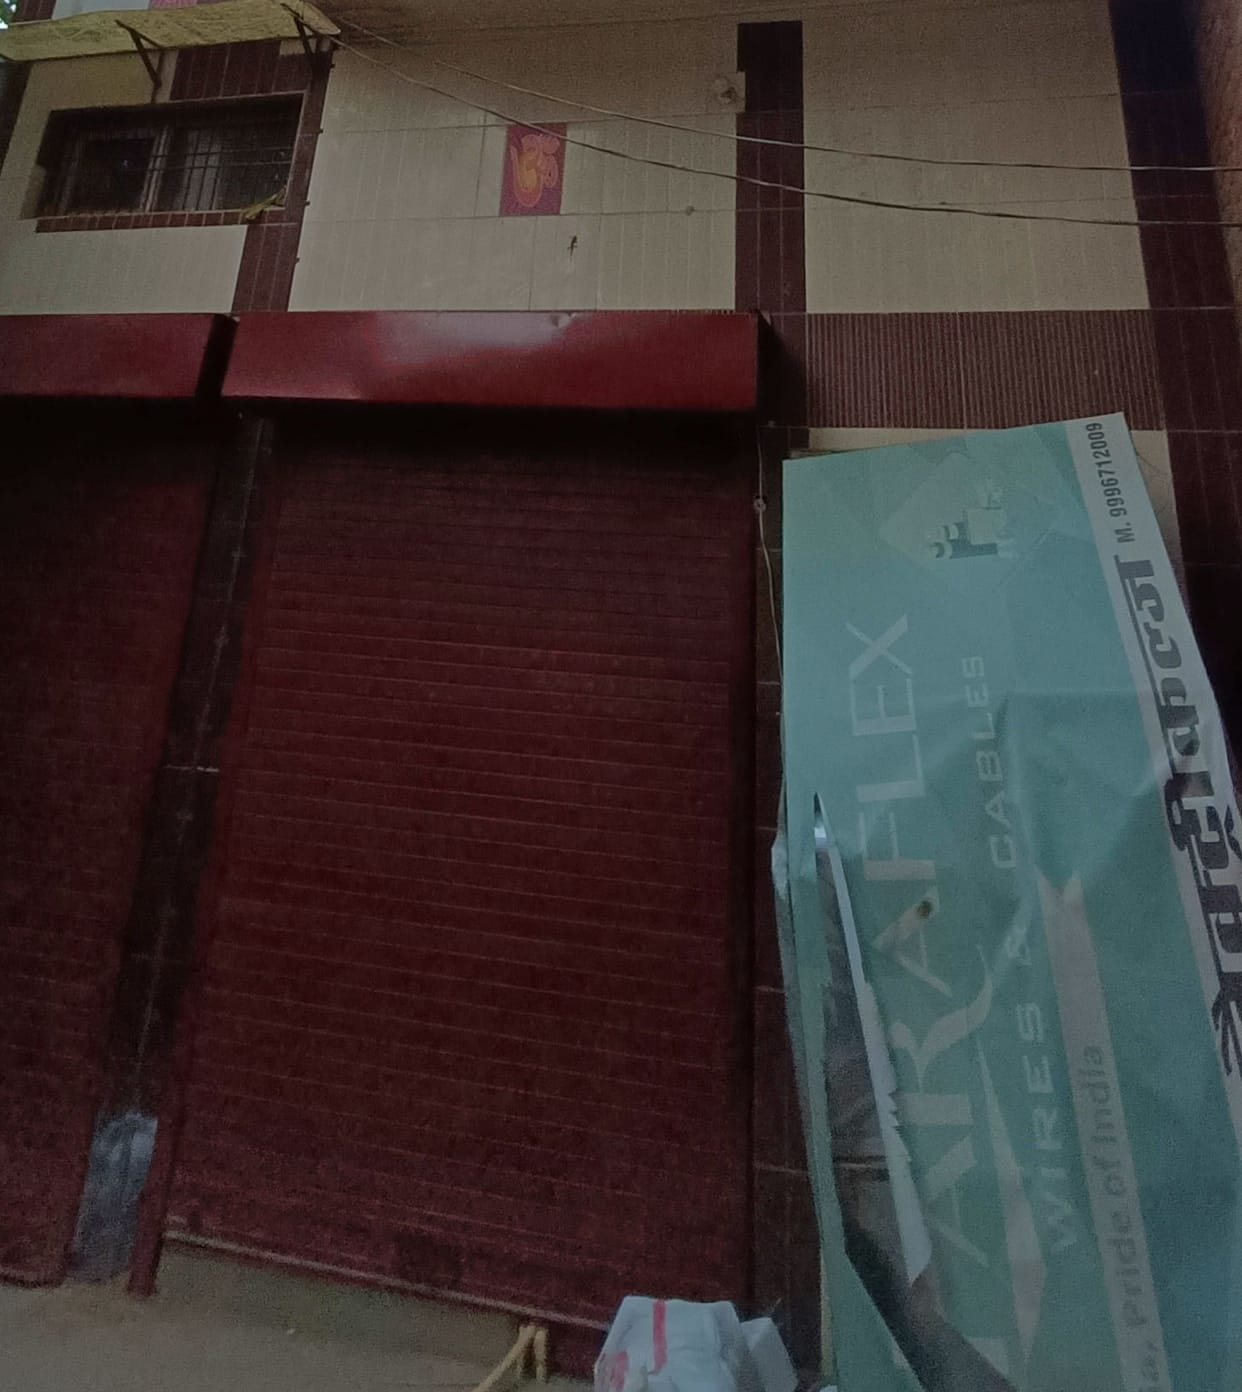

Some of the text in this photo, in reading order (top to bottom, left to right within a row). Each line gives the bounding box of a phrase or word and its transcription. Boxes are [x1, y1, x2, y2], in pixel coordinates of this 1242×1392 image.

[1085, 422, 1136, 545] M. 9996712009
[960, 654, 1018, 869] CABLES
[845, 614, 1009, 1380] ARAFLEX
[1015, 1001, 1078, 1252] WIRES
[1078, 1044, 1147, 1330] Pride of India
